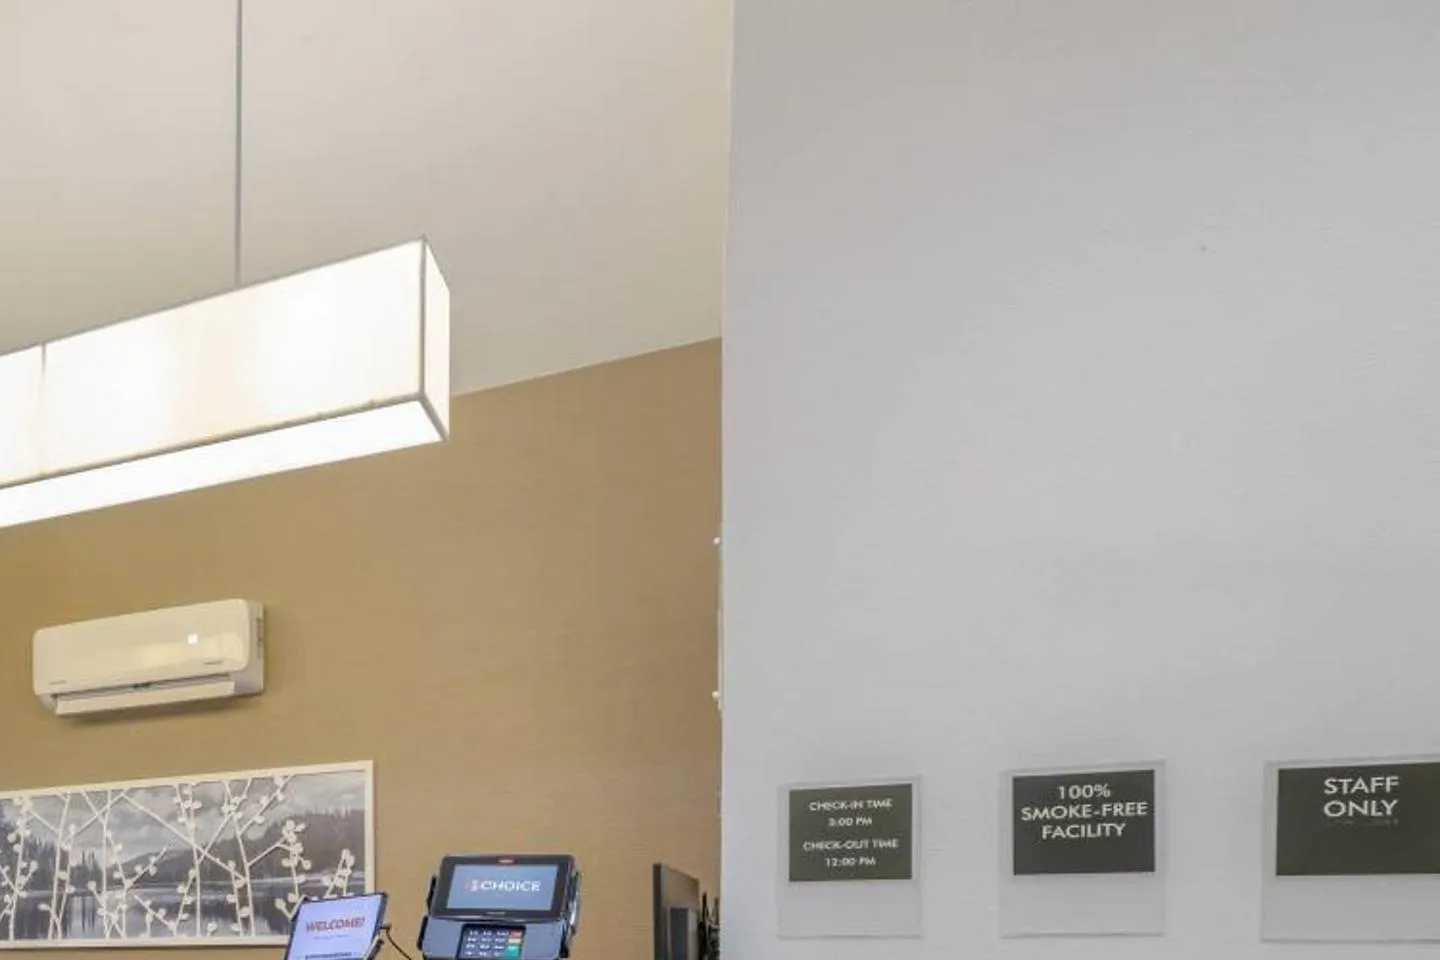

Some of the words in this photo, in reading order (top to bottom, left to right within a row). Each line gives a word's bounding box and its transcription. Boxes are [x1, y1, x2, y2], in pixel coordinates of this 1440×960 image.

[1058, 783, 1112, 800] 100%
[1323, 776, 1399, 794] STAFF
[808, 800, 863, 811] CHECK-IN
[866, 799, 893, 808] TIME
[1020, 801, 1148, 821] SMOKE-FREE
[1323, 799, 1399, 817] ONLY
[855, 817, 873, 826] PM
[1041, 823, 1127, 840] FACILITY
[803, 840, 869, 851] CHECK-OUT
[871, 838, 899, 849] TIME
[825, 857, 856, 868] 12:00
[859, 856, 877, 866] PM
[480, 880, 542, 893] CHOICE
